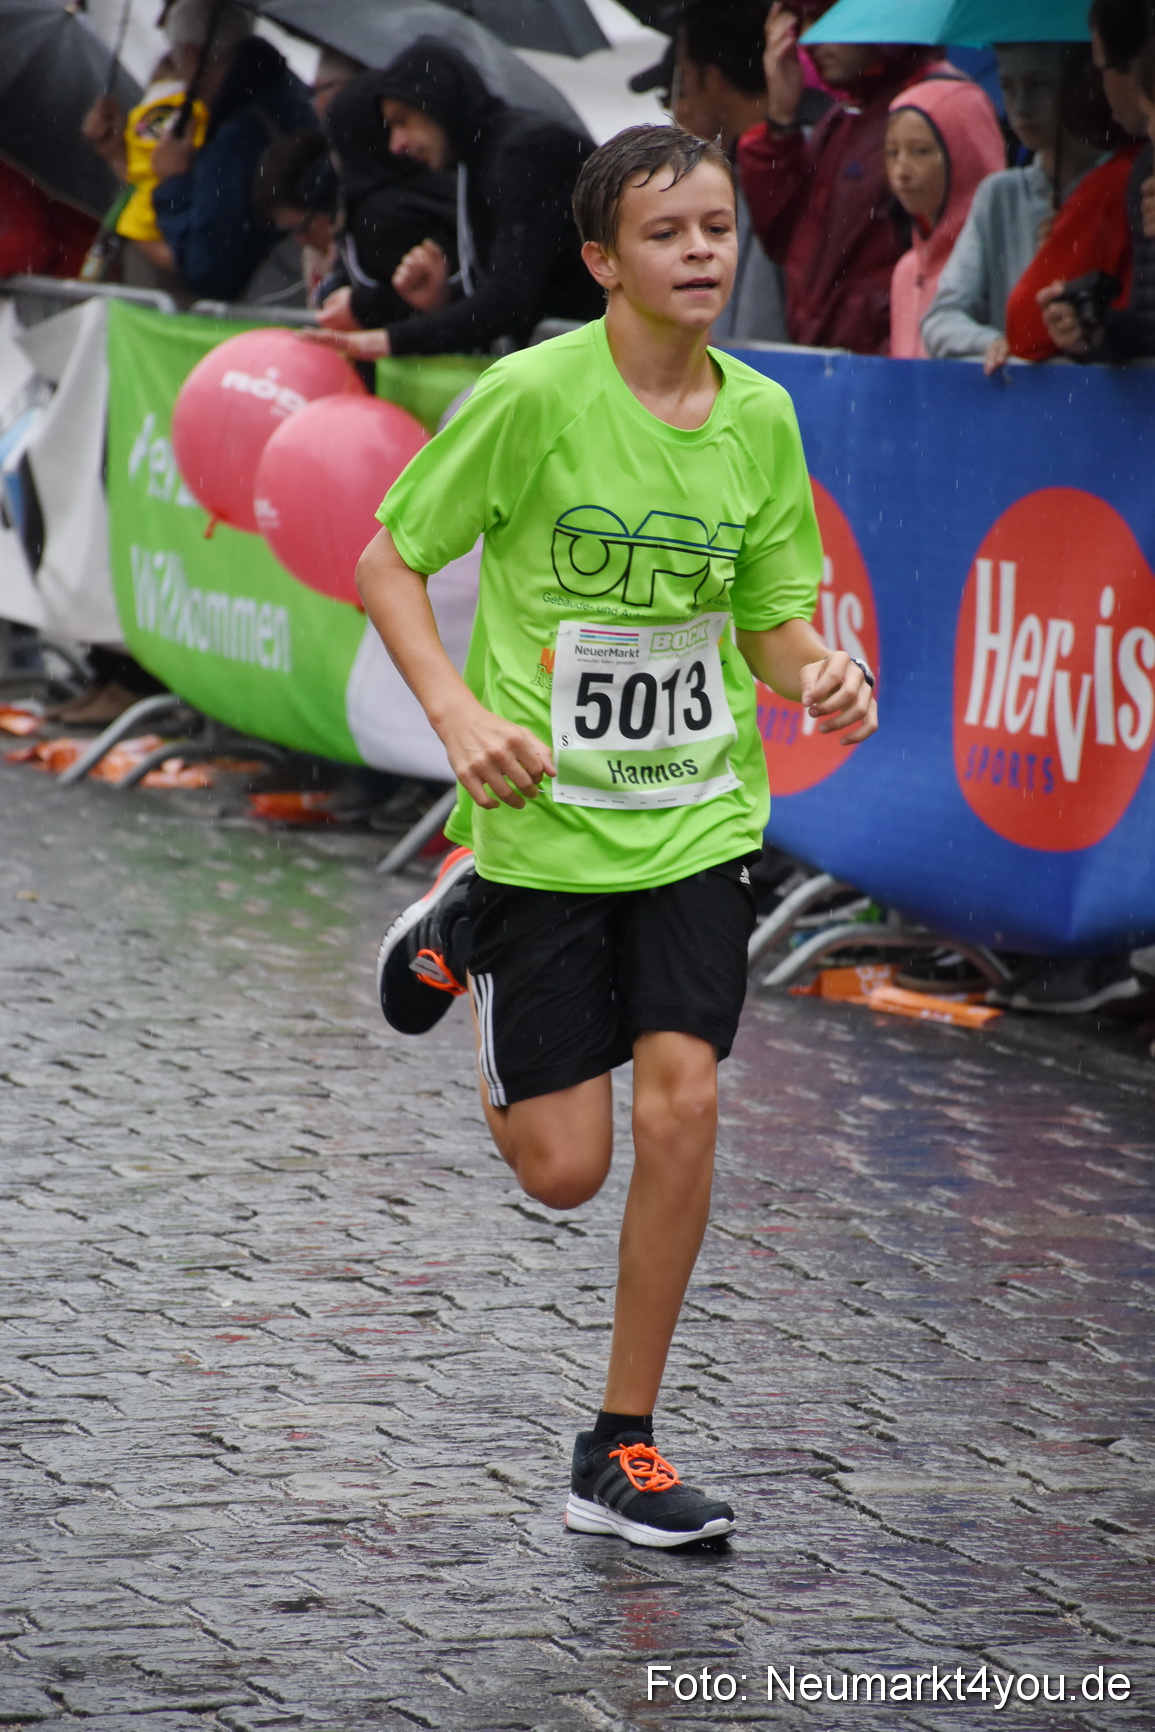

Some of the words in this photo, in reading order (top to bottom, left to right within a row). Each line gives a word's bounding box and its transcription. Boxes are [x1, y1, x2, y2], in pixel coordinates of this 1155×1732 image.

[542, 592, 594, 611] Gebäude-
[597, 604, 619, 617] und
[574, 644, 640, 659] NeuerMarkt
[649, 620, 710, 653] BOCK
[963, 557, 1155, 783] Hervis
[575, 660, 712, 740] 5013
[606, 758, 699, 785] Hannes
[964, 744, 1055, 794] SPORTS
